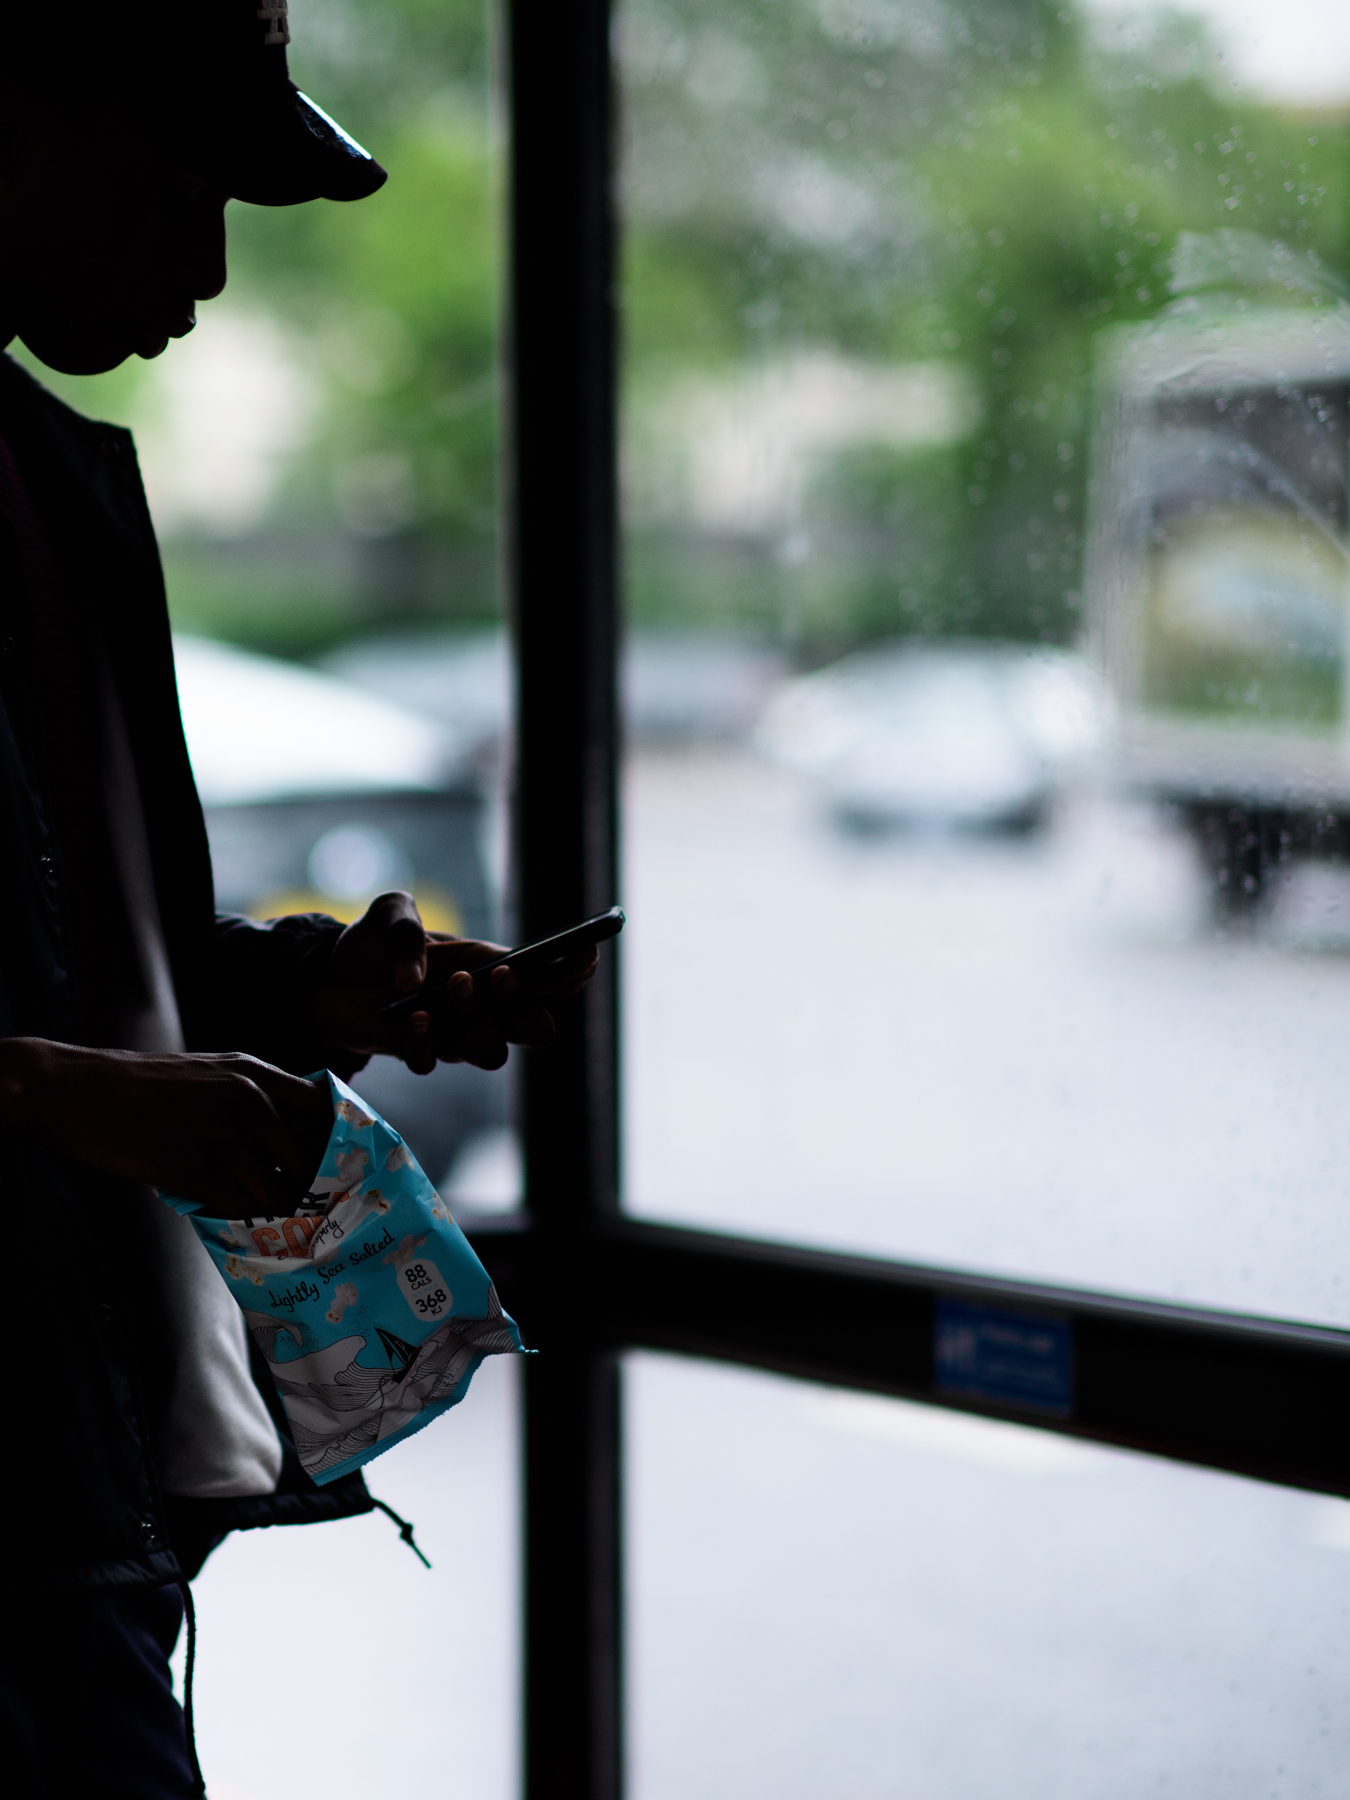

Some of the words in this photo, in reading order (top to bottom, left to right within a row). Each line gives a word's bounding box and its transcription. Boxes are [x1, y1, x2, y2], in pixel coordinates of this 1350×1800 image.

[268, 1281, 320, 1313] Lightly
[317, 1263, 347, 1285] Sea
[349, 1226, 396, 1266] Salted
[405, 1264, 427, 1282] 88
[411, 1276, 432, 1290] CALS
[415, 1289, 447, 1313] 368
[430, 1305, 443, 1316] KJ
